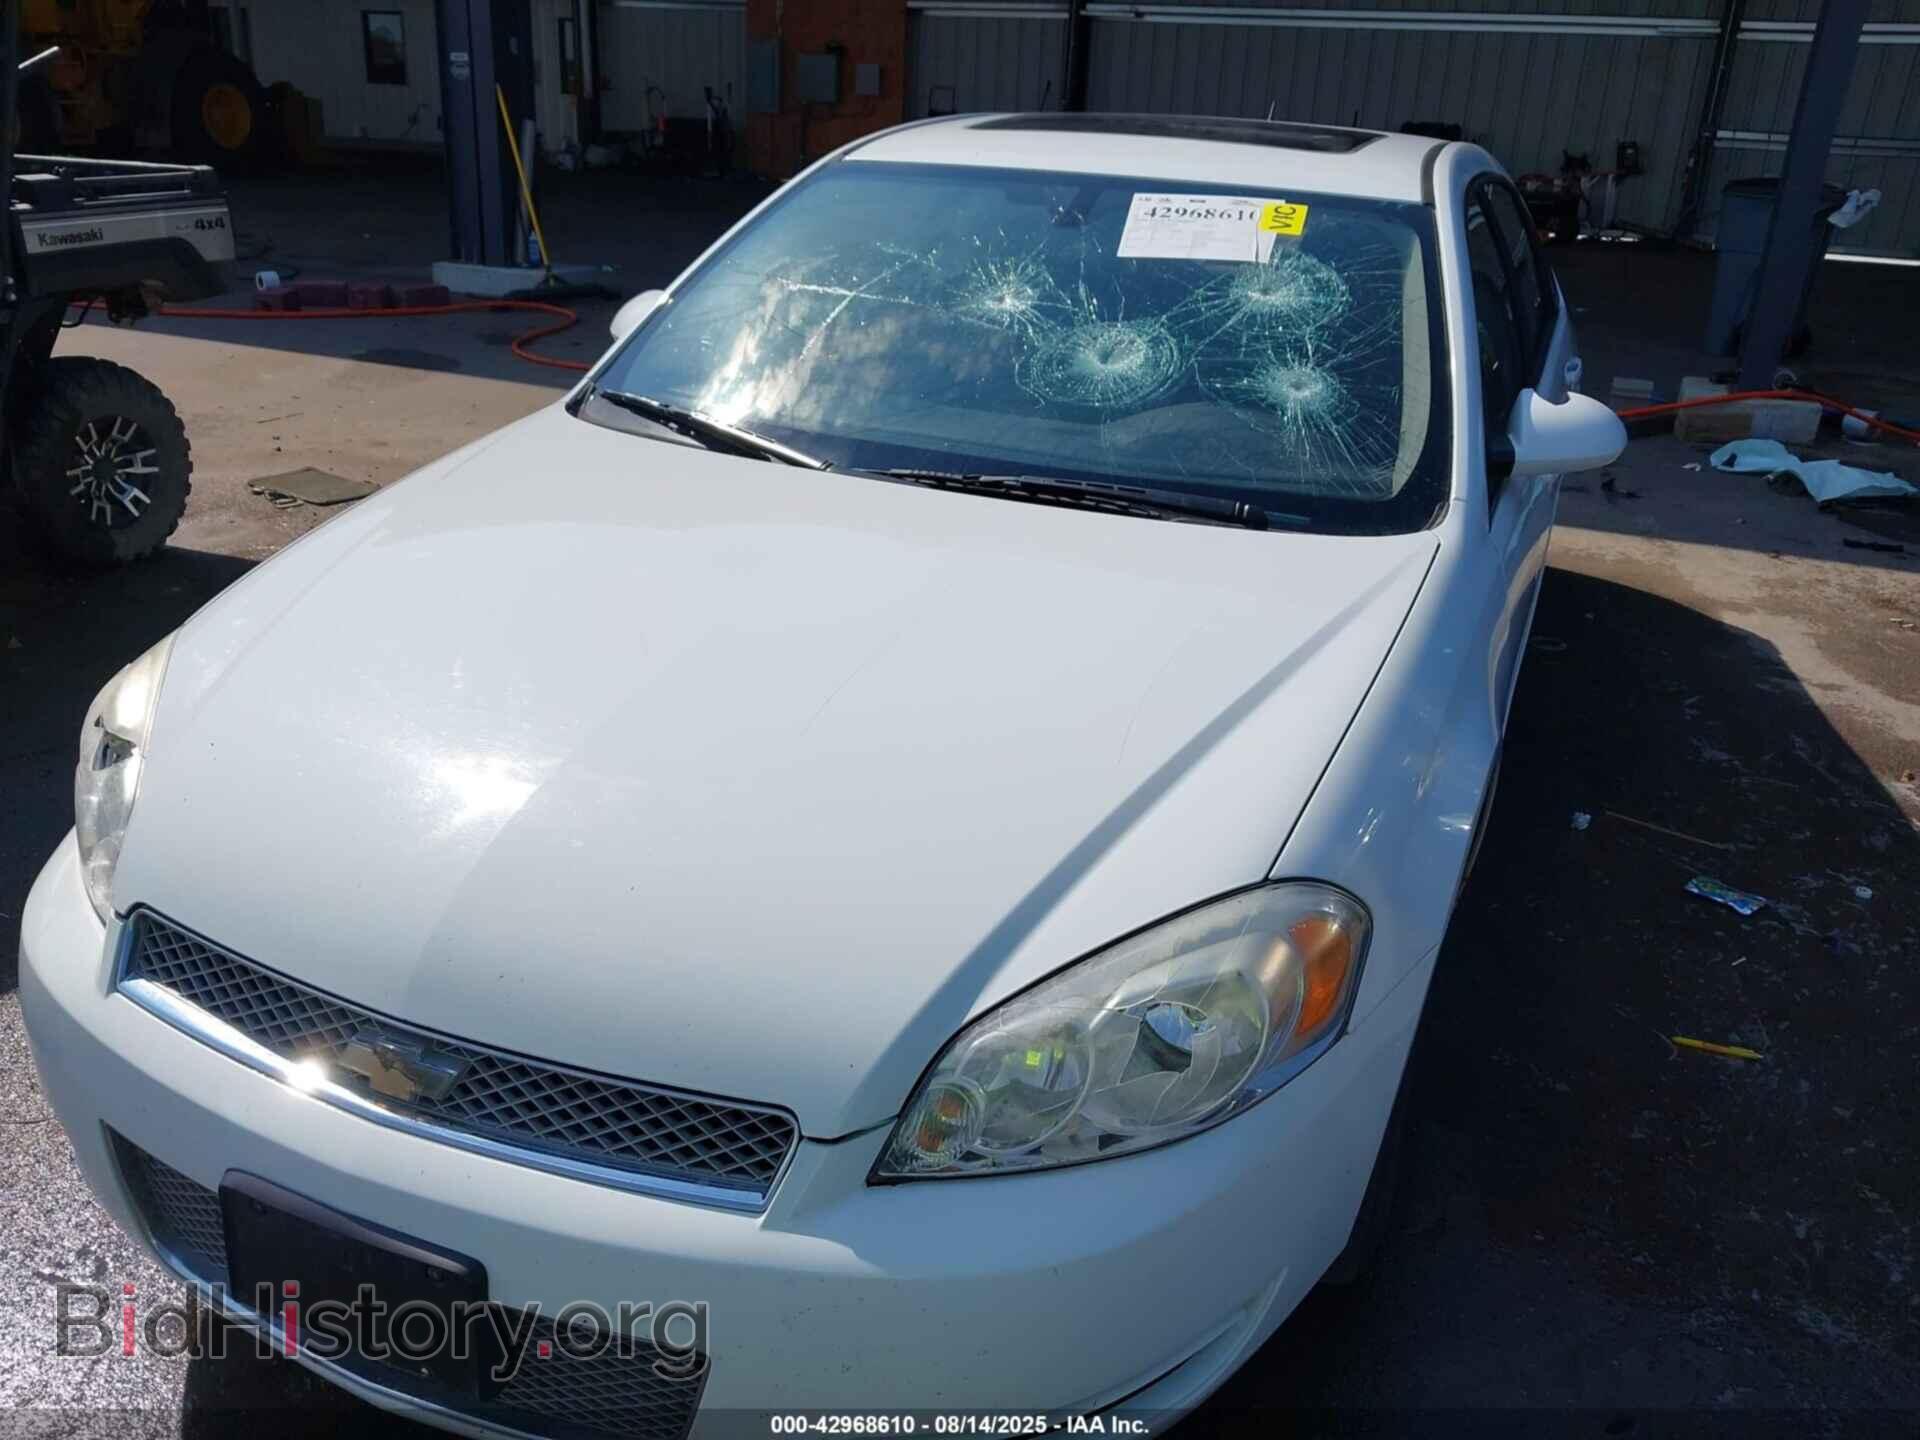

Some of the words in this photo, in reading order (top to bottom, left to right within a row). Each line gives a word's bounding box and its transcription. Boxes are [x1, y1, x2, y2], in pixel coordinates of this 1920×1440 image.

[194, 216, 226, 231] 4x4
[1269, 205, 1297, 230] VIC
[37, 227, 104, 247] Kawasaki
